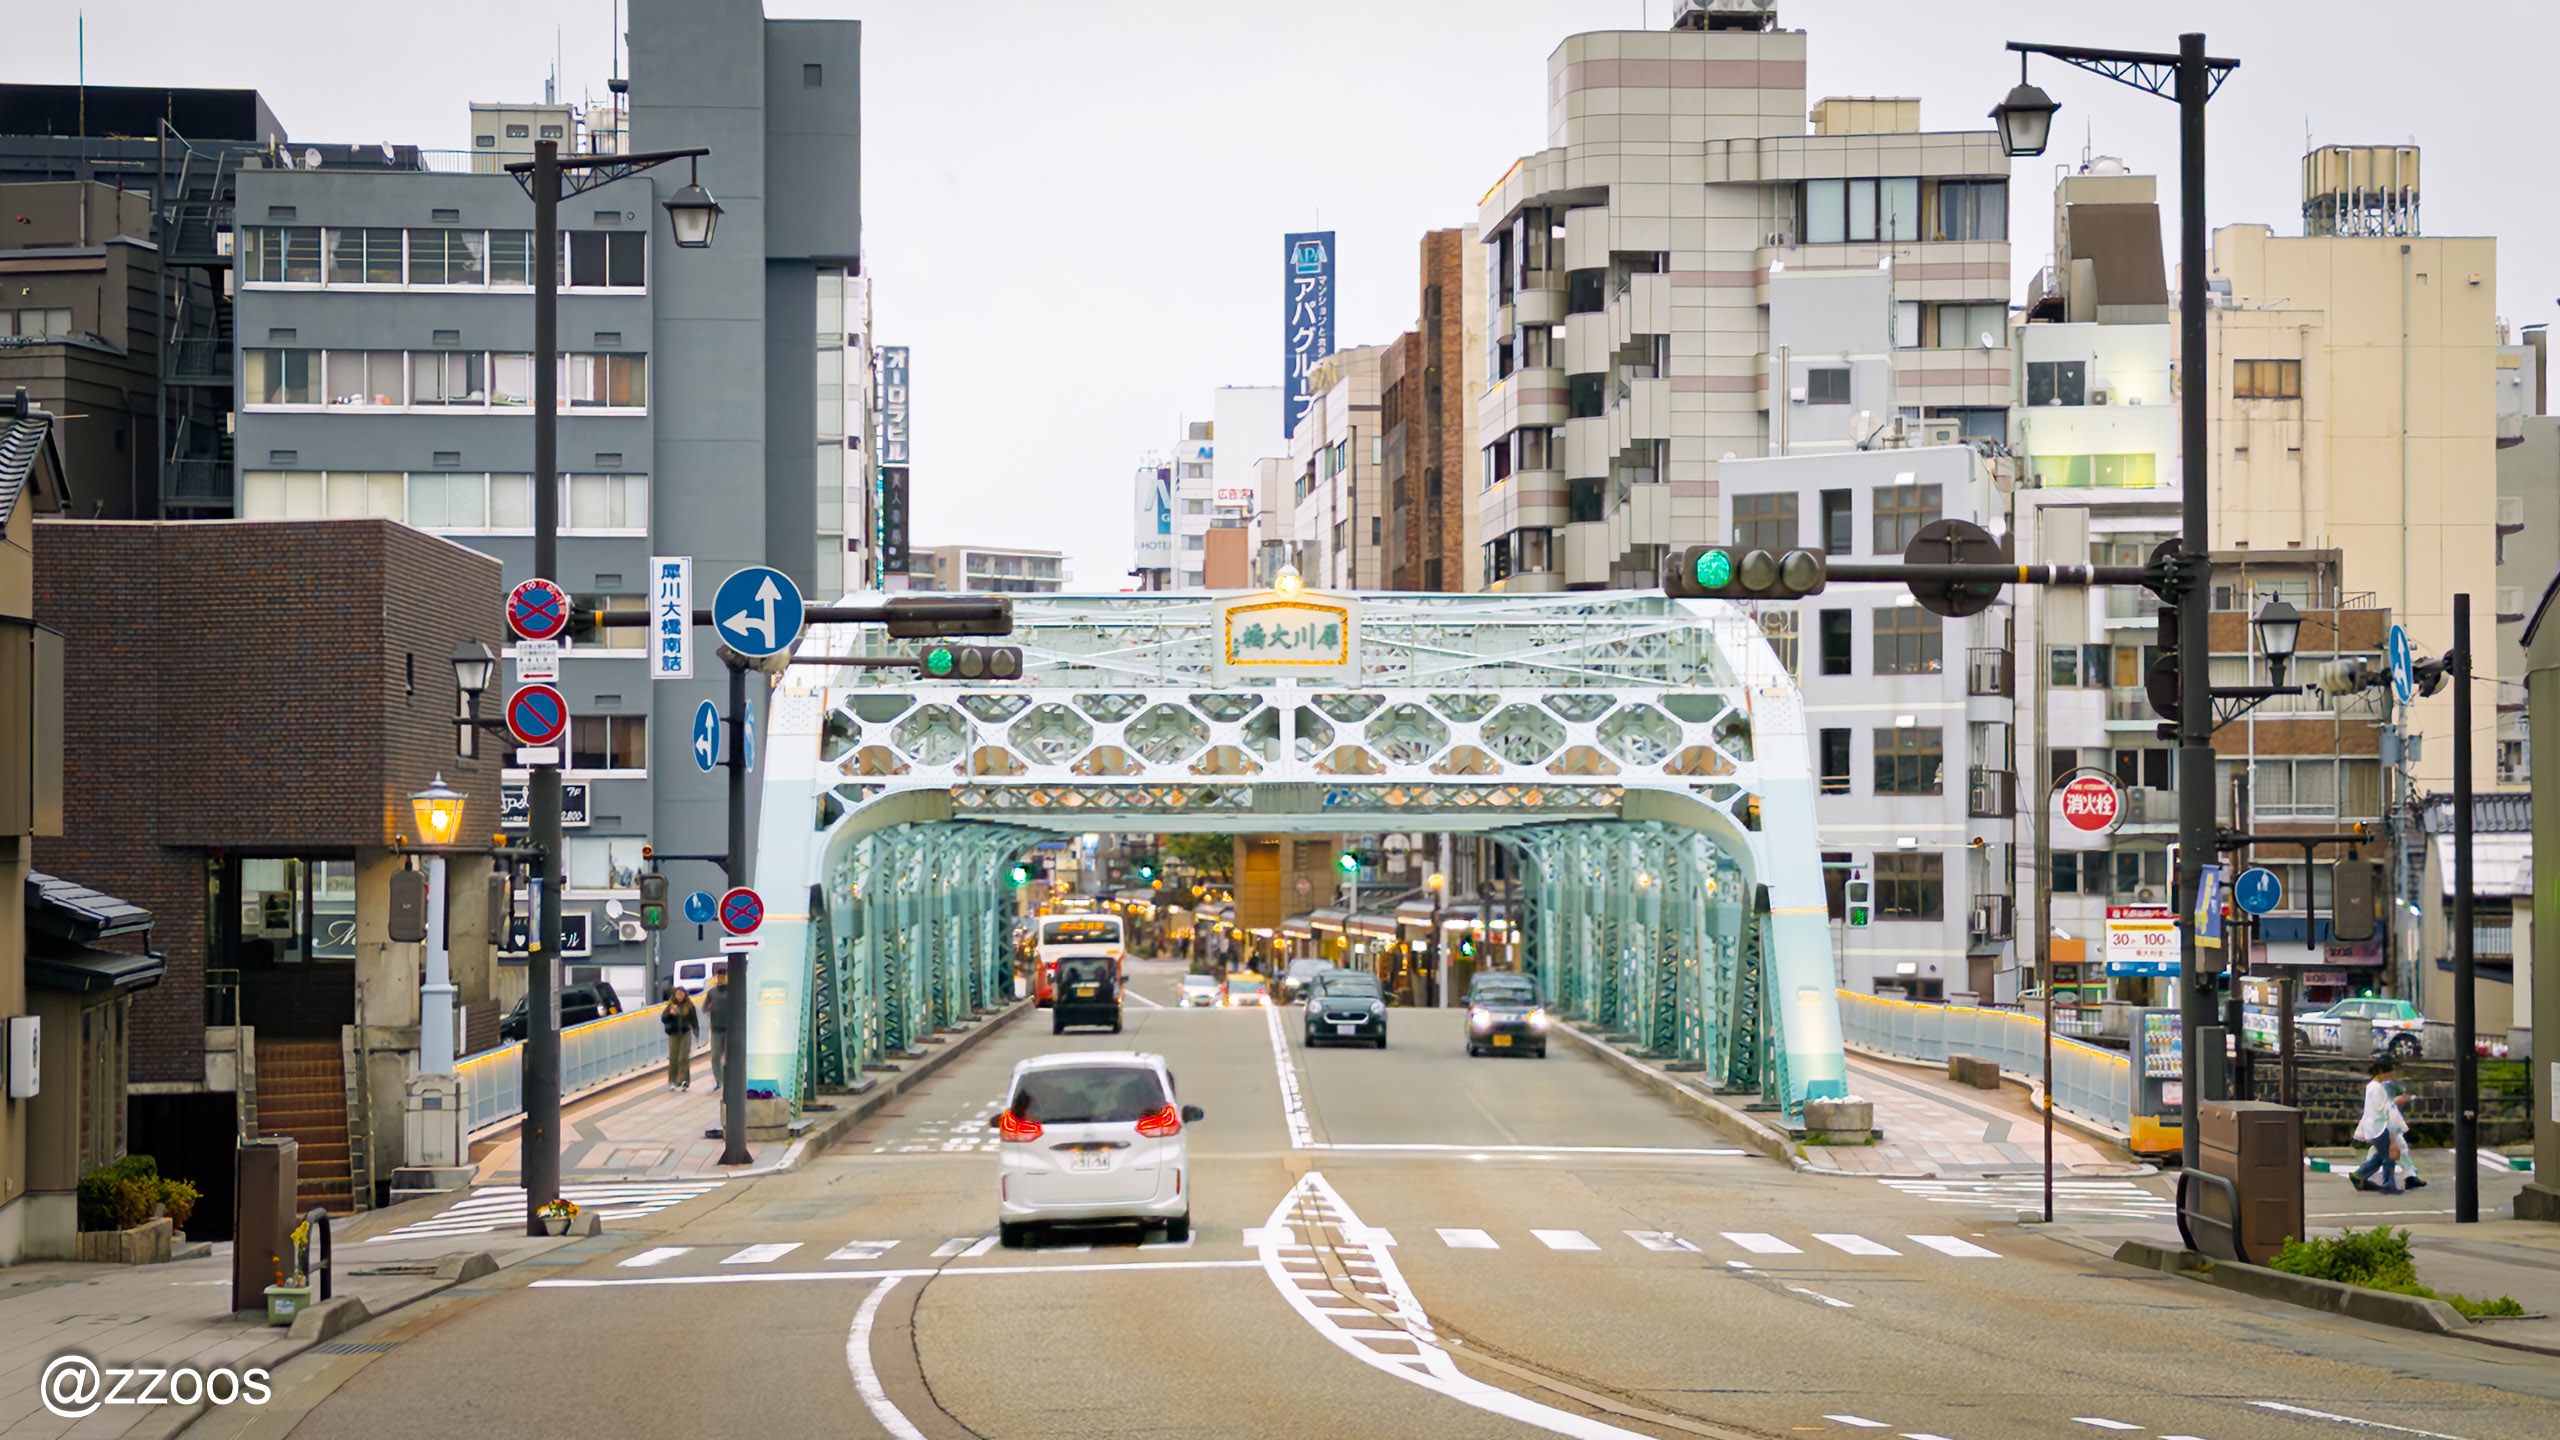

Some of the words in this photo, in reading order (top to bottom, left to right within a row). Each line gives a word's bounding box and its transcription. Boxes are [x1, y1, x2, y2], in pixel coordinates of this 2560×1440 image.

[887, 350, 906, 461] オーロラビル
[661, 564, 681, 671] 犀川大橋南詰
[2067, 793, 2113, 815] 消火栓
